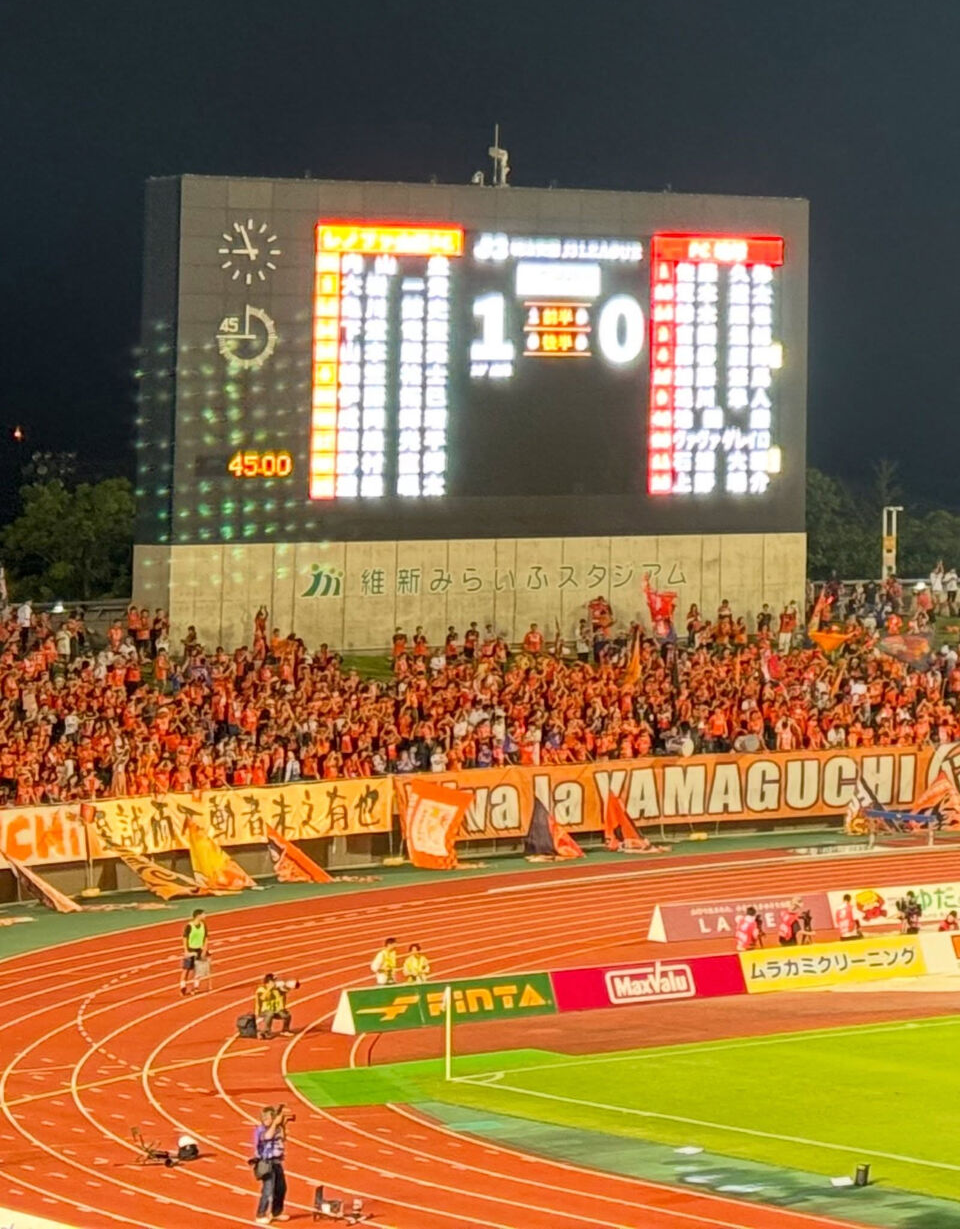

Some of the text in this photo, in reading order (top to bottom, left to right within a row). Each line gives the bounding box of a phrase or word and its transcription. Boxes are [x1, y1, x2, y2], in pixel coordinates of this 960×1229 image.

[219, 318, 239, 332] 45
[471, 293, 513, 360] 1
[599, 295, 644, 362] 0
[361, 564, 687, 595] 維新みらいふスタジアム
[593, 753, 917, 823] YAMAGUCHI
[613, 962, 688, 996] MaxValu
[751, 947, 915, 979] ムラカミクリーニング
